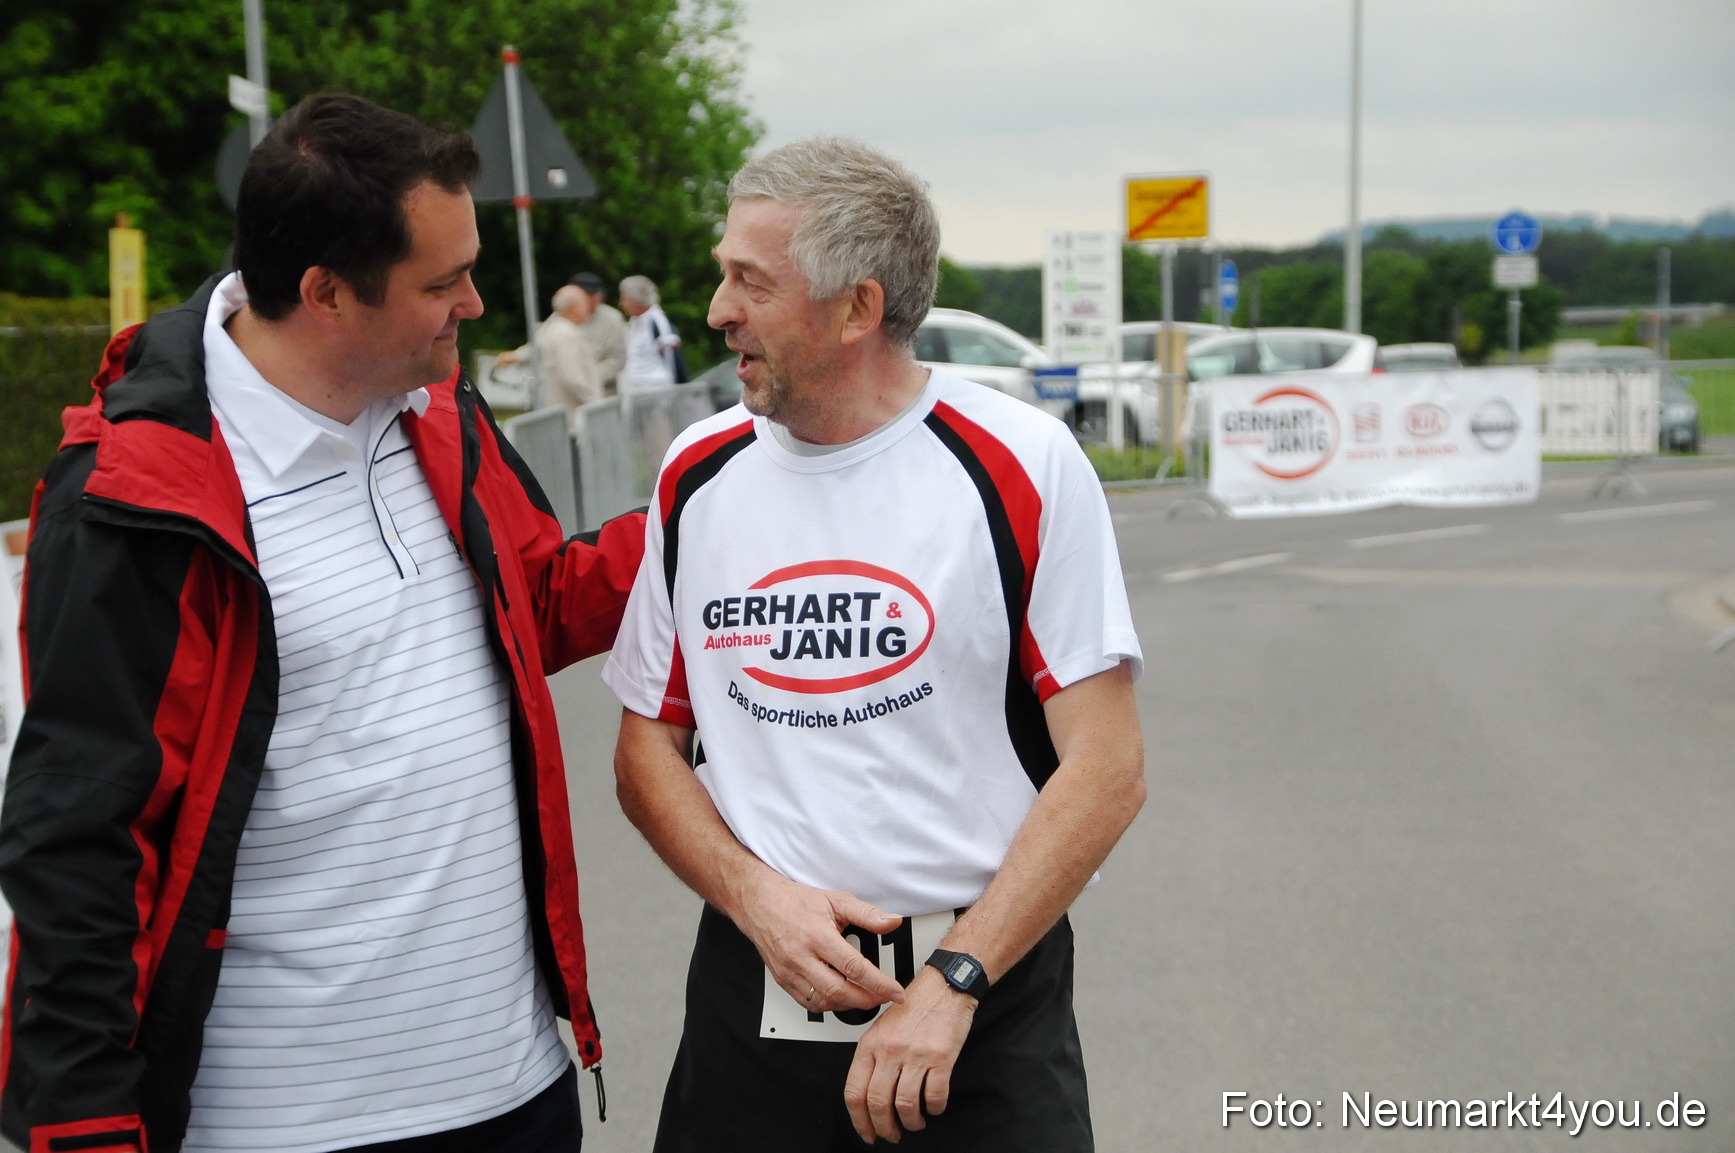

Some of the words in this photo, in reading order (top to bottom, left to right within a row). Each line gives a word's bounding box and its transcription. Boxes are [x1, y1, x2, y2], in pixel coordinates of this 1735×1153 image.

[1221, 409, 1315, 432] GERHART
[702, 592, 881, 630] GERHART
[886, 601, 902, 619] &
[703, 632, 772, 650] Autohaus
[769, 626, 907, 661] JÄNIG
[727, 680, 749, 712] Das
[751, 704, 838, 729] sportliche
[843, 681, 934, 726] Autohaus
[807, 916, 915, 1026] 01
